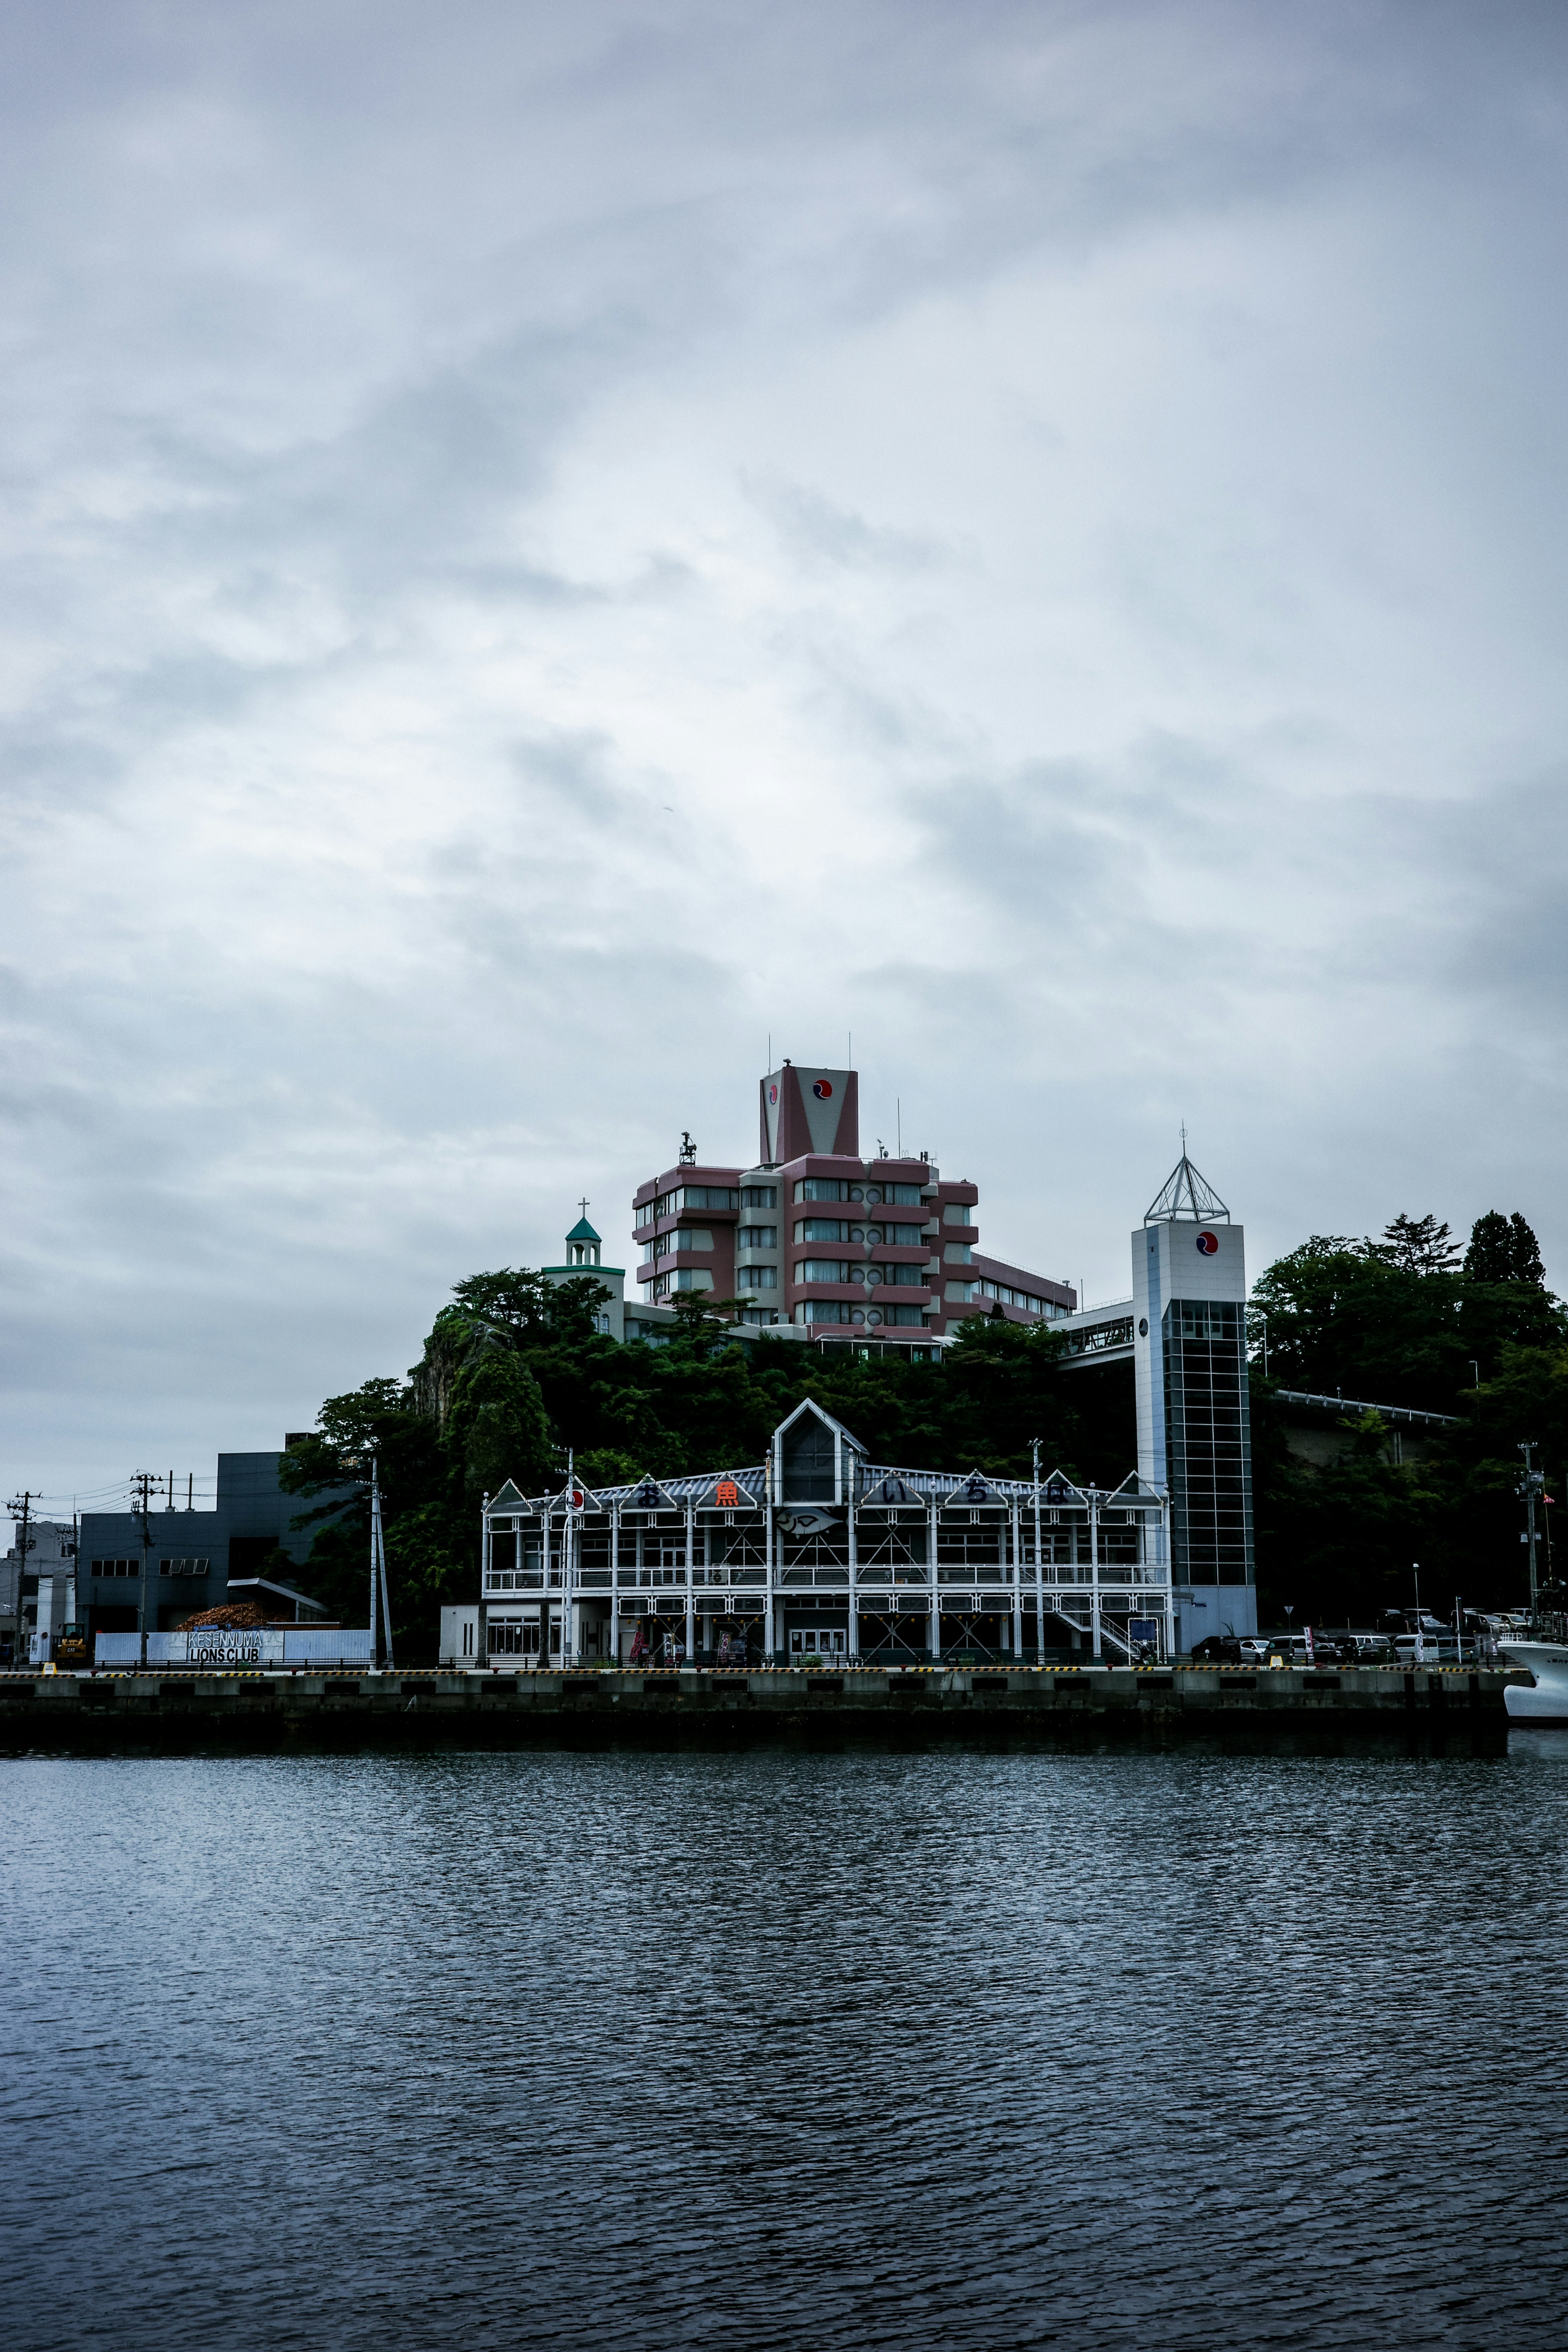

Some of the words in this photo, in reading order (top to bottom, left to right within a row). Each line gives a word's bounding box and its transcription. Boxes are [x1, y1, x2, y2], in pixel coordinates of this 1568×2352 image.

[188, 1632, 262, 1648] KESENNUMA
[190, 1648, 225, 1662] LIONS
[227, 1648, 259, 1662] CLUB
